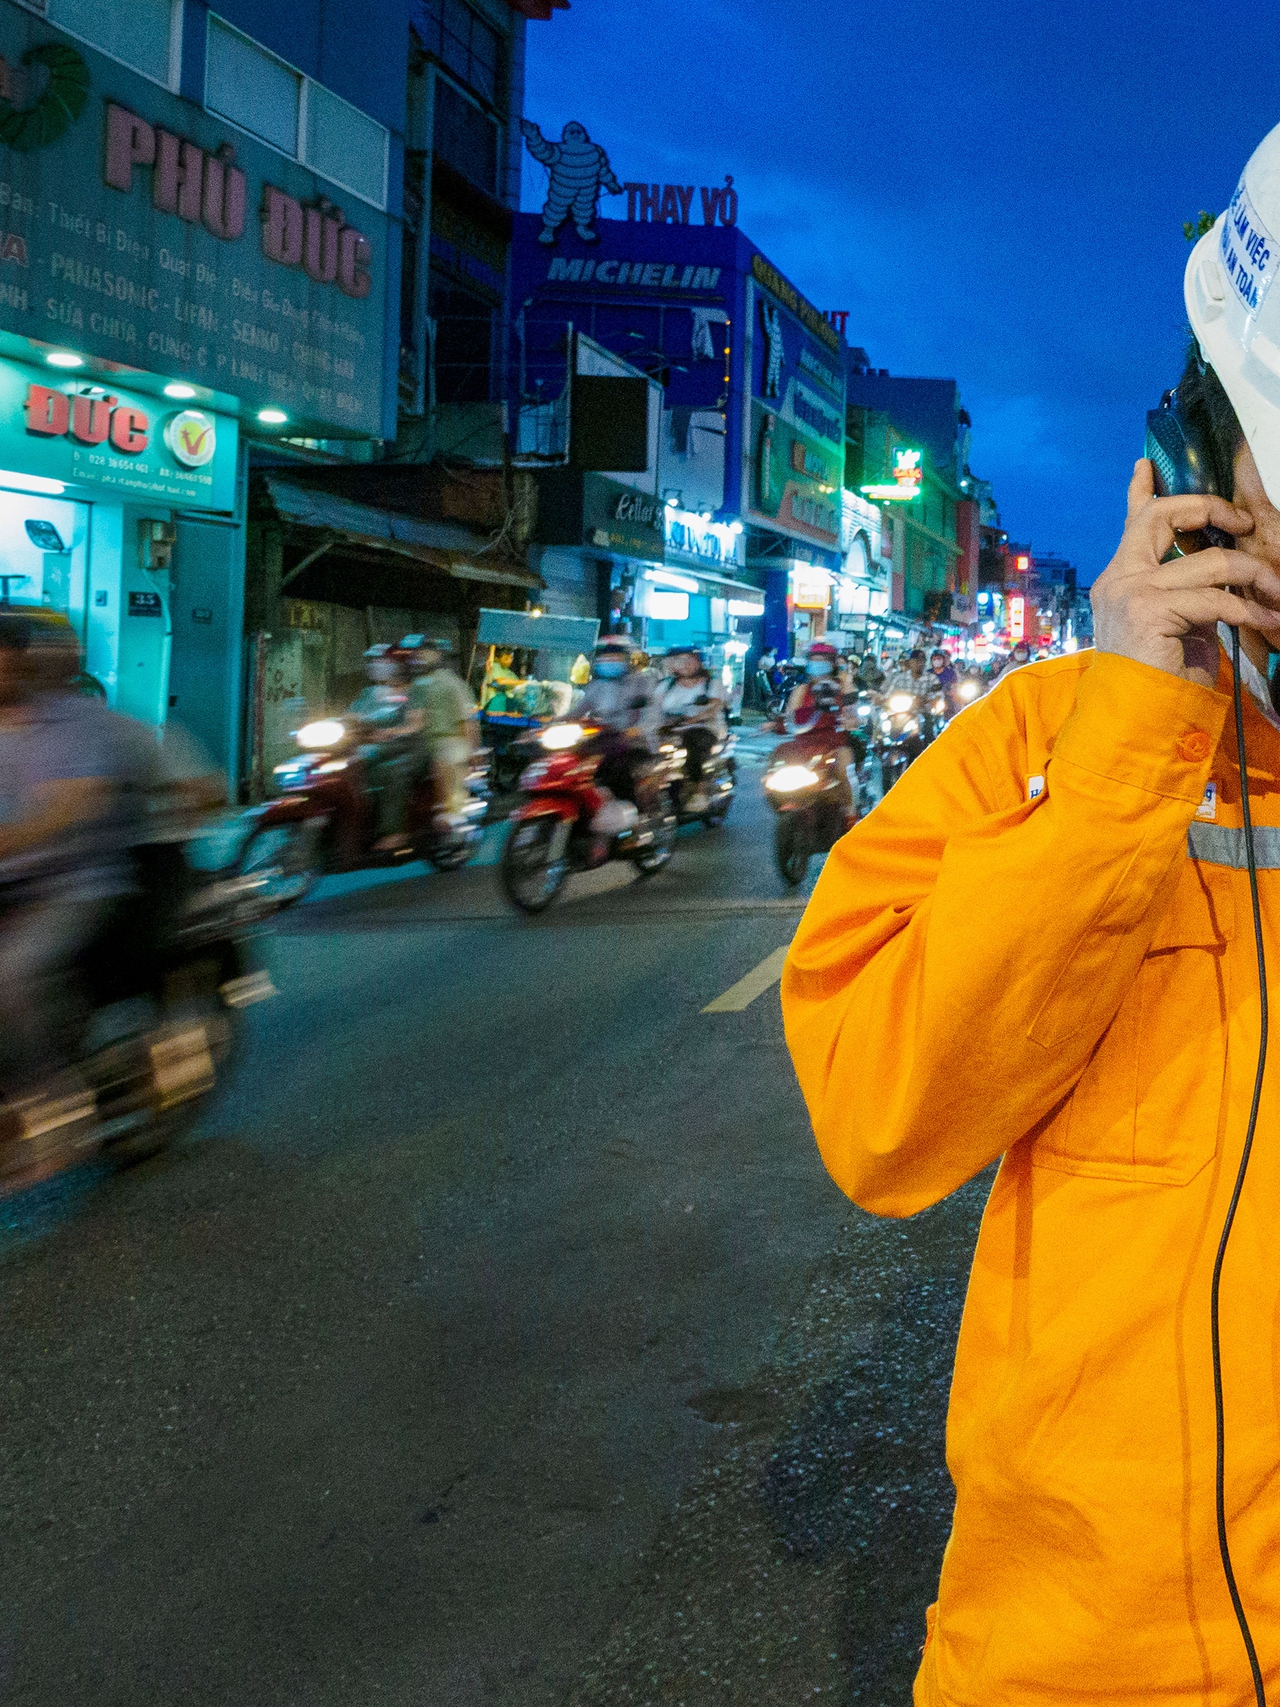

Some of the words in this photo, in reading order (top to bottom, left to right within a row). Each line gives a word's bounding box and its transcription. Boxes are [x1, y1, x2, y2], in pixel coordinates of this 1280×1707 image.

[104, 101, 247, 242] PHÚ
[260, 184, 372, 299] ĐỨC
[624, 182, 694, 225] THAY
[700, 175, 738, 227] VỎ
[548, 257, 721, 290] MICHELIN
[1245, 227, 1271, 272] VIỆC
[24, 384, 149, 454] ĐỨC
